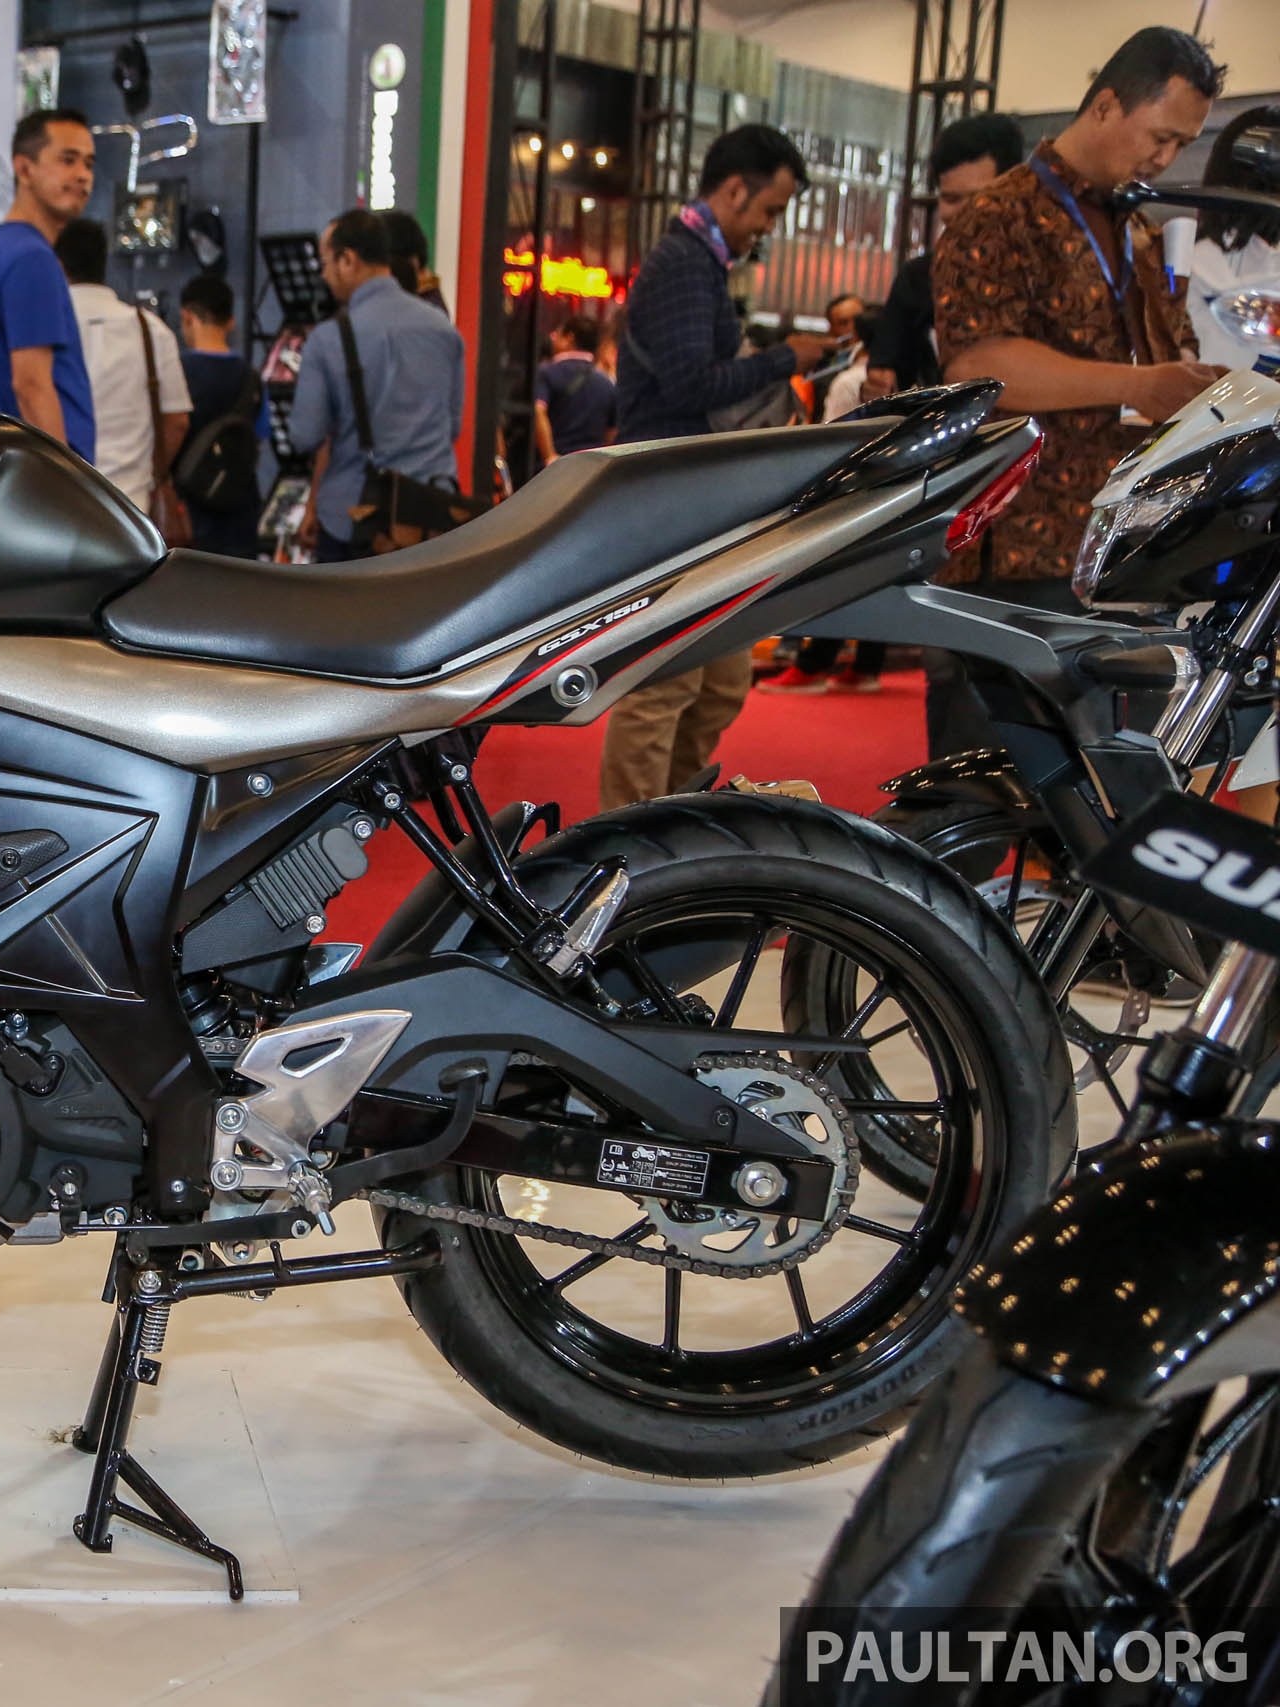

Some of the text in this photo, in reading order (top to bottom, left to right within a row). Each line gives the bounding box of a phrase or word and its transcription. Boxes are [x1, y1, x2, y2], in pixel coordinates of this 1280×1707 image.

[538, 596, 650, 656] GSX150
[1131, 828, 1280, 922] SU
[797, 1363, 919, 1432] DUNLOP
